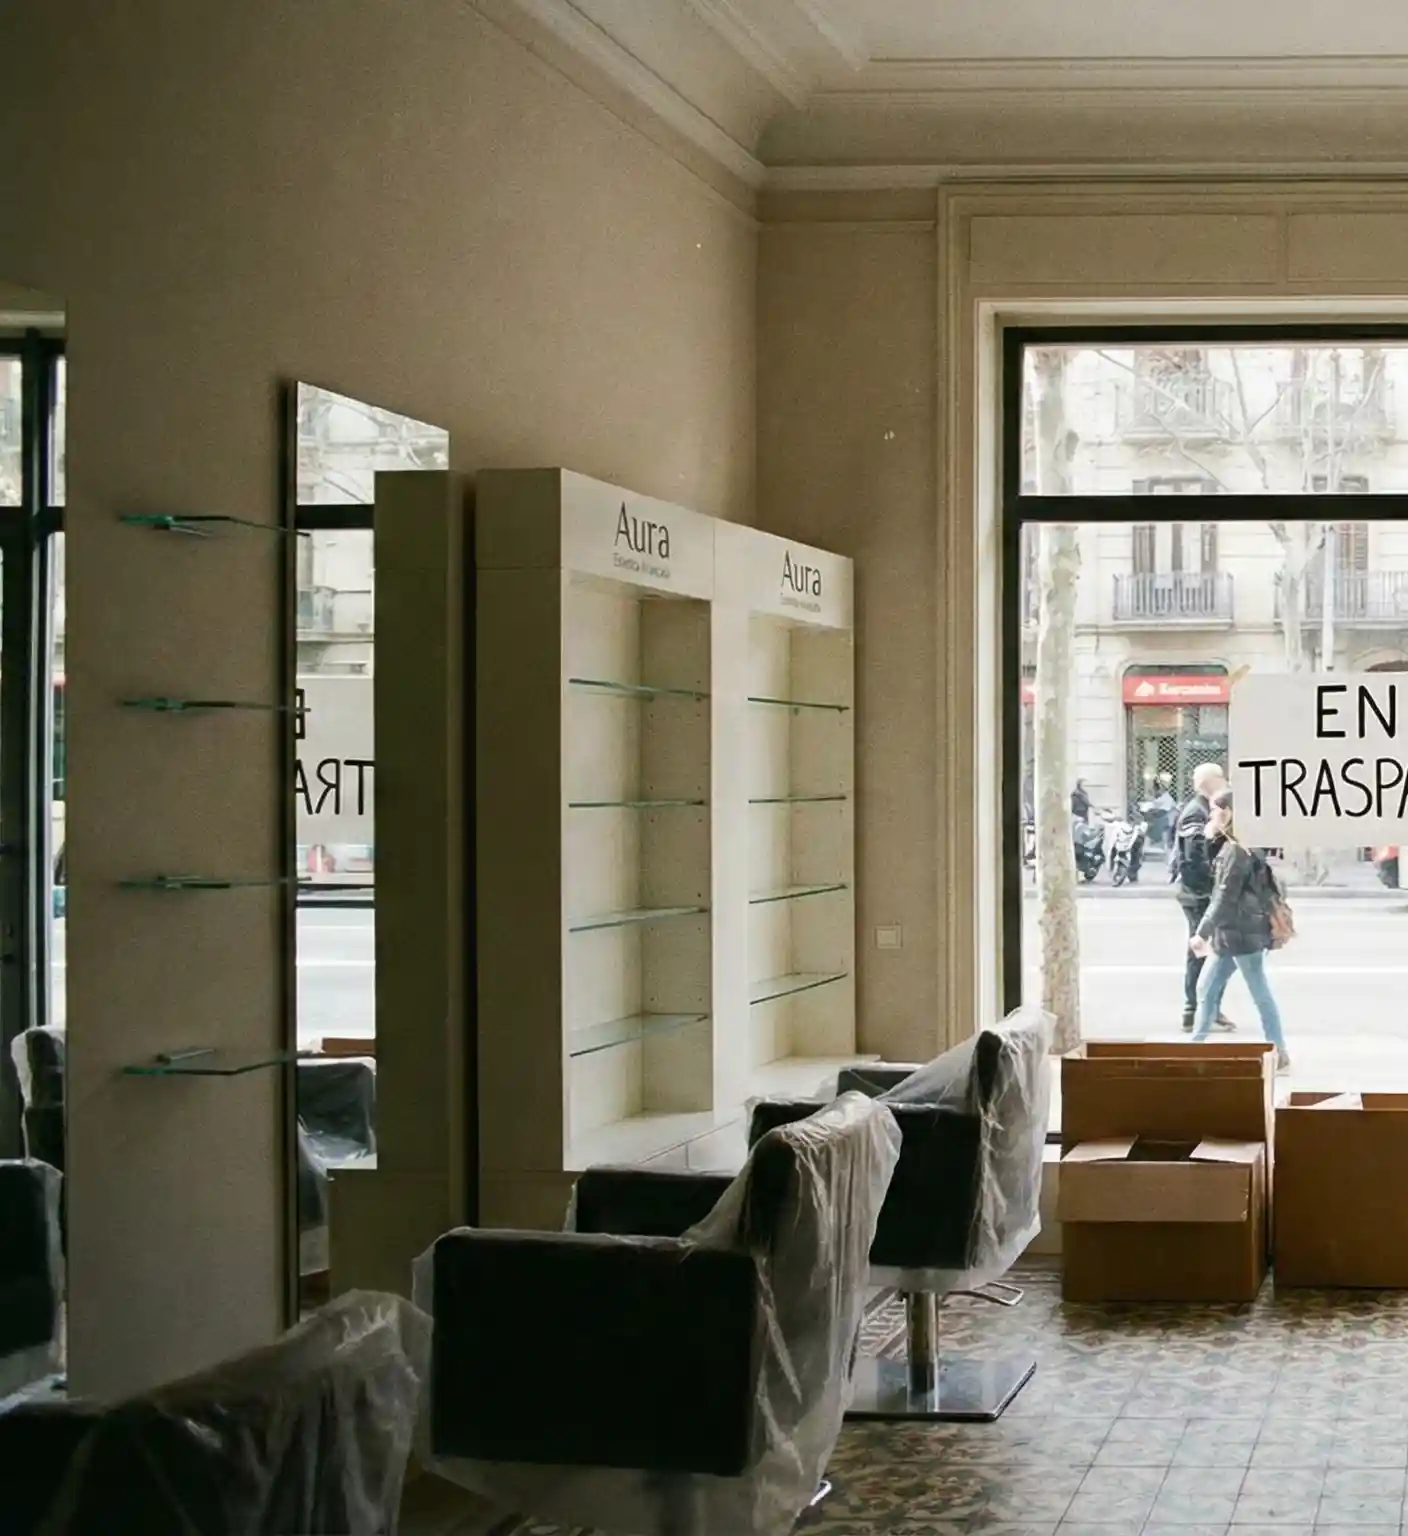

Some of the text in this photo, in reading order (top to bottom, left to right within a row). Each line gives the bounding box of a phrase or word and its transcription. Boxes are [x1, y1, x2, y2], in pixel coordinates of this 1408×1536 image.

[614, 501, 670, 559] Aura
[780, 549, 822, 596] Aura
[1316, 684, 1397, 739] EN
